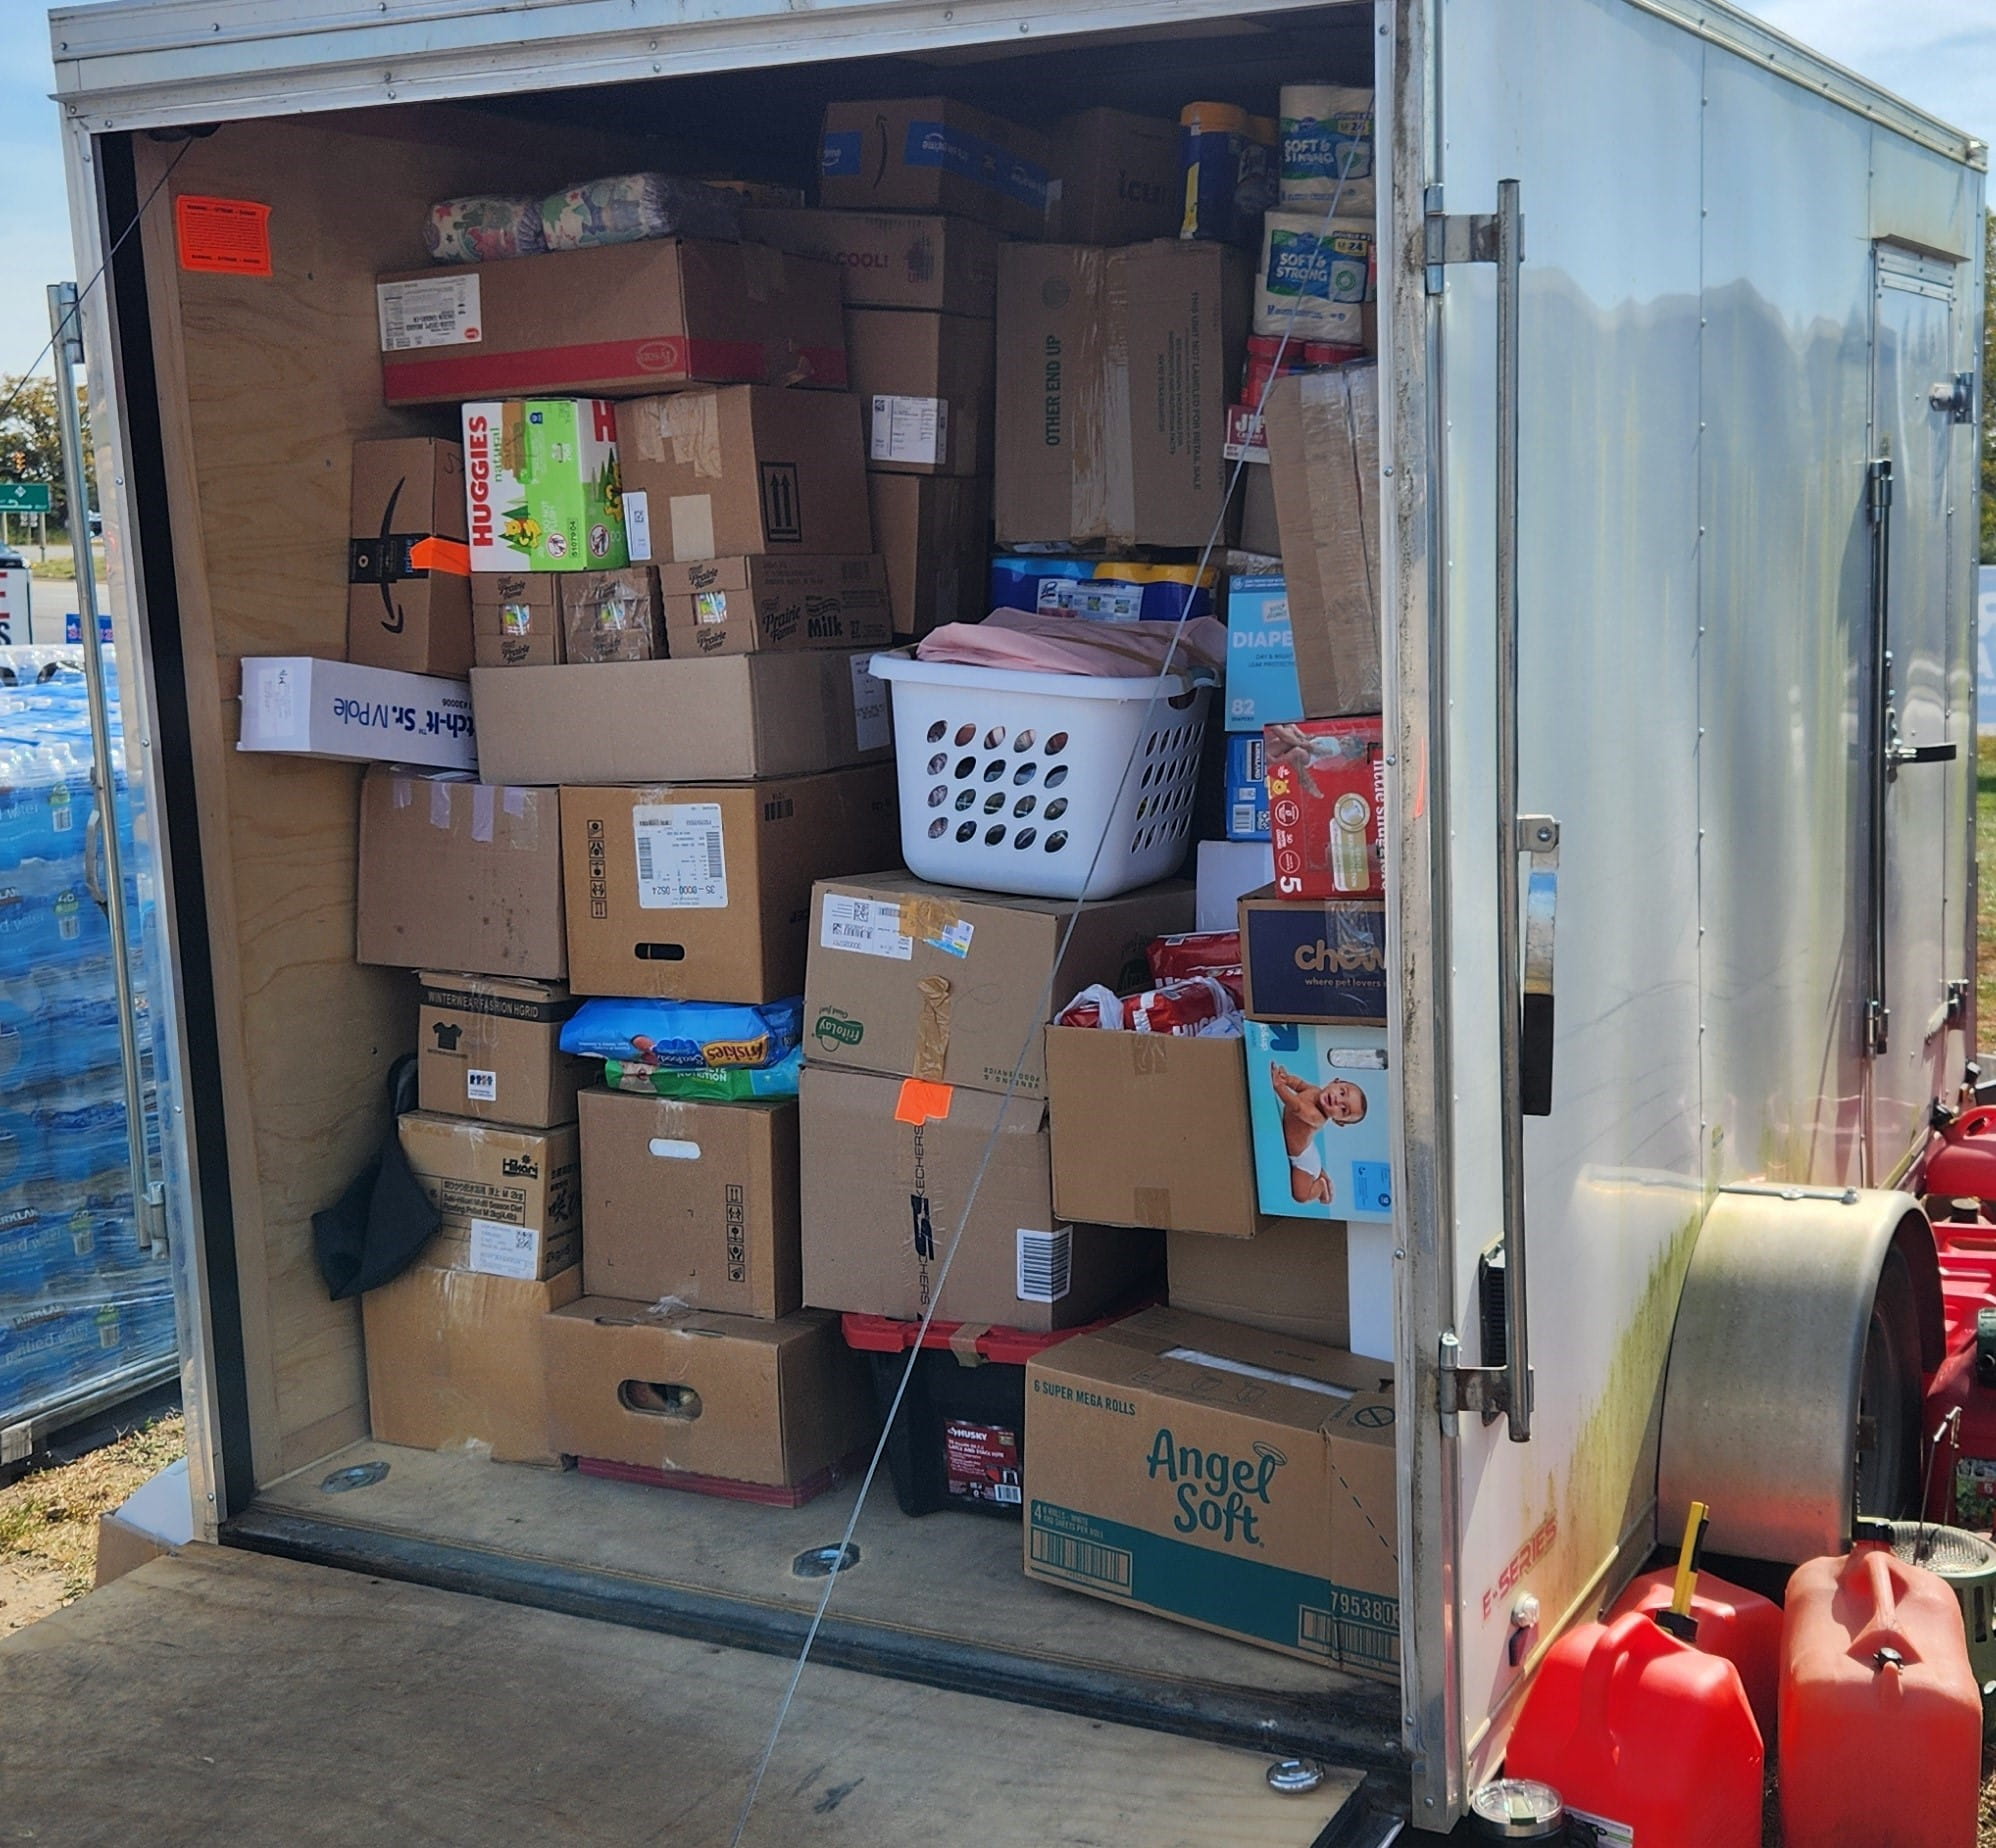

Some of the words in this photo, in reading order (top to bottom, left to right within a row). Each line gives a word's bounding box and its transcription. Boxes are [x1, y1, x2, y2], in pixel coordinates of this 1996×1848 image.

[1284, 139, 1319, 153] SOFT
[1284, 151, 1335, 165] STRONG
[1279, 252, 1315, 268] SOFT
[1275, 266, 1328, 282] STRONG
[1045, 334, 1062, 357] UP
[1044, 360, 1061, 393] END
[1044, 395, 1062, 447] OTHER
[490, 427, 503, 483] natural
[468, 415, 493, 547] HUGGIES
[806, 615, 843, 639] Milk
[333, 697, 370, 726] Pole
[371, 703, 389, 729] IV
[391, 705, 417, 732] Sr.
[1230, 697, 1256, 717] 82
[1280, 876, 1302, 893] 5
[1304, 976, 1335, 987] where
[1335, 978, 1351, 989] pet
[1352, 978, 1382, 988] lovers
[427, 990, 480, 1011] WINTERWEAR
[995, 1075, 1039, 1089] VENNG
[1033, 1379, 1041, 1393] 6
[1042, 1381, 1075, 1401] SUPER
[1075, 1390, 1104, 1409] MEGA
[1104, 1397, 1136, 1416] ROLLS
[956, 1428, 988, 1441] HUSKY
[1146, 1428, 1282, 1503] Angel
[1033, 1503, 1042, 1522] 4
[1173, 1481, 1261, 1545] Soft
[1481, 1515, 1558, 1621] E-SERIES
